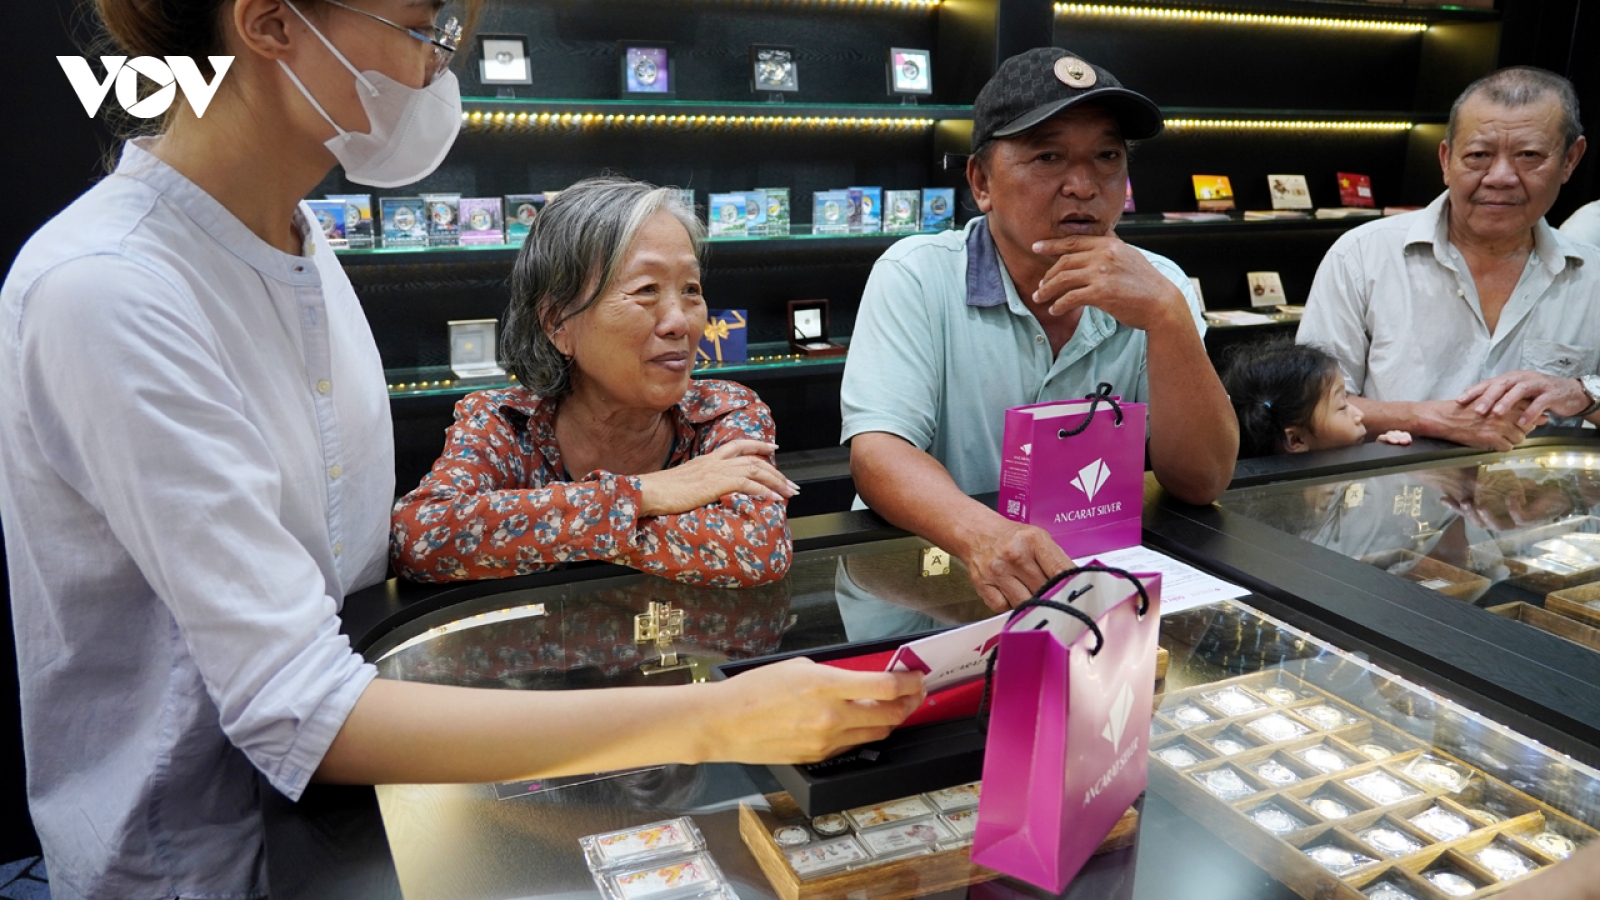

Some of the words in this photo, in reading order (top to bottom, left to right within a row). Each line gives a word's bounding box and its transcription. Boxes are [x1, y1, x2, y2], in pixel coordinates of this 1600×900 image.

[1053, 506, 1096, 524] ANCARAT
[1097, 500, 1122, 516] SILVER
[1082, 759, 1120, 809] ANCARAT
[1119, 735, 1139, 771] SILVER
